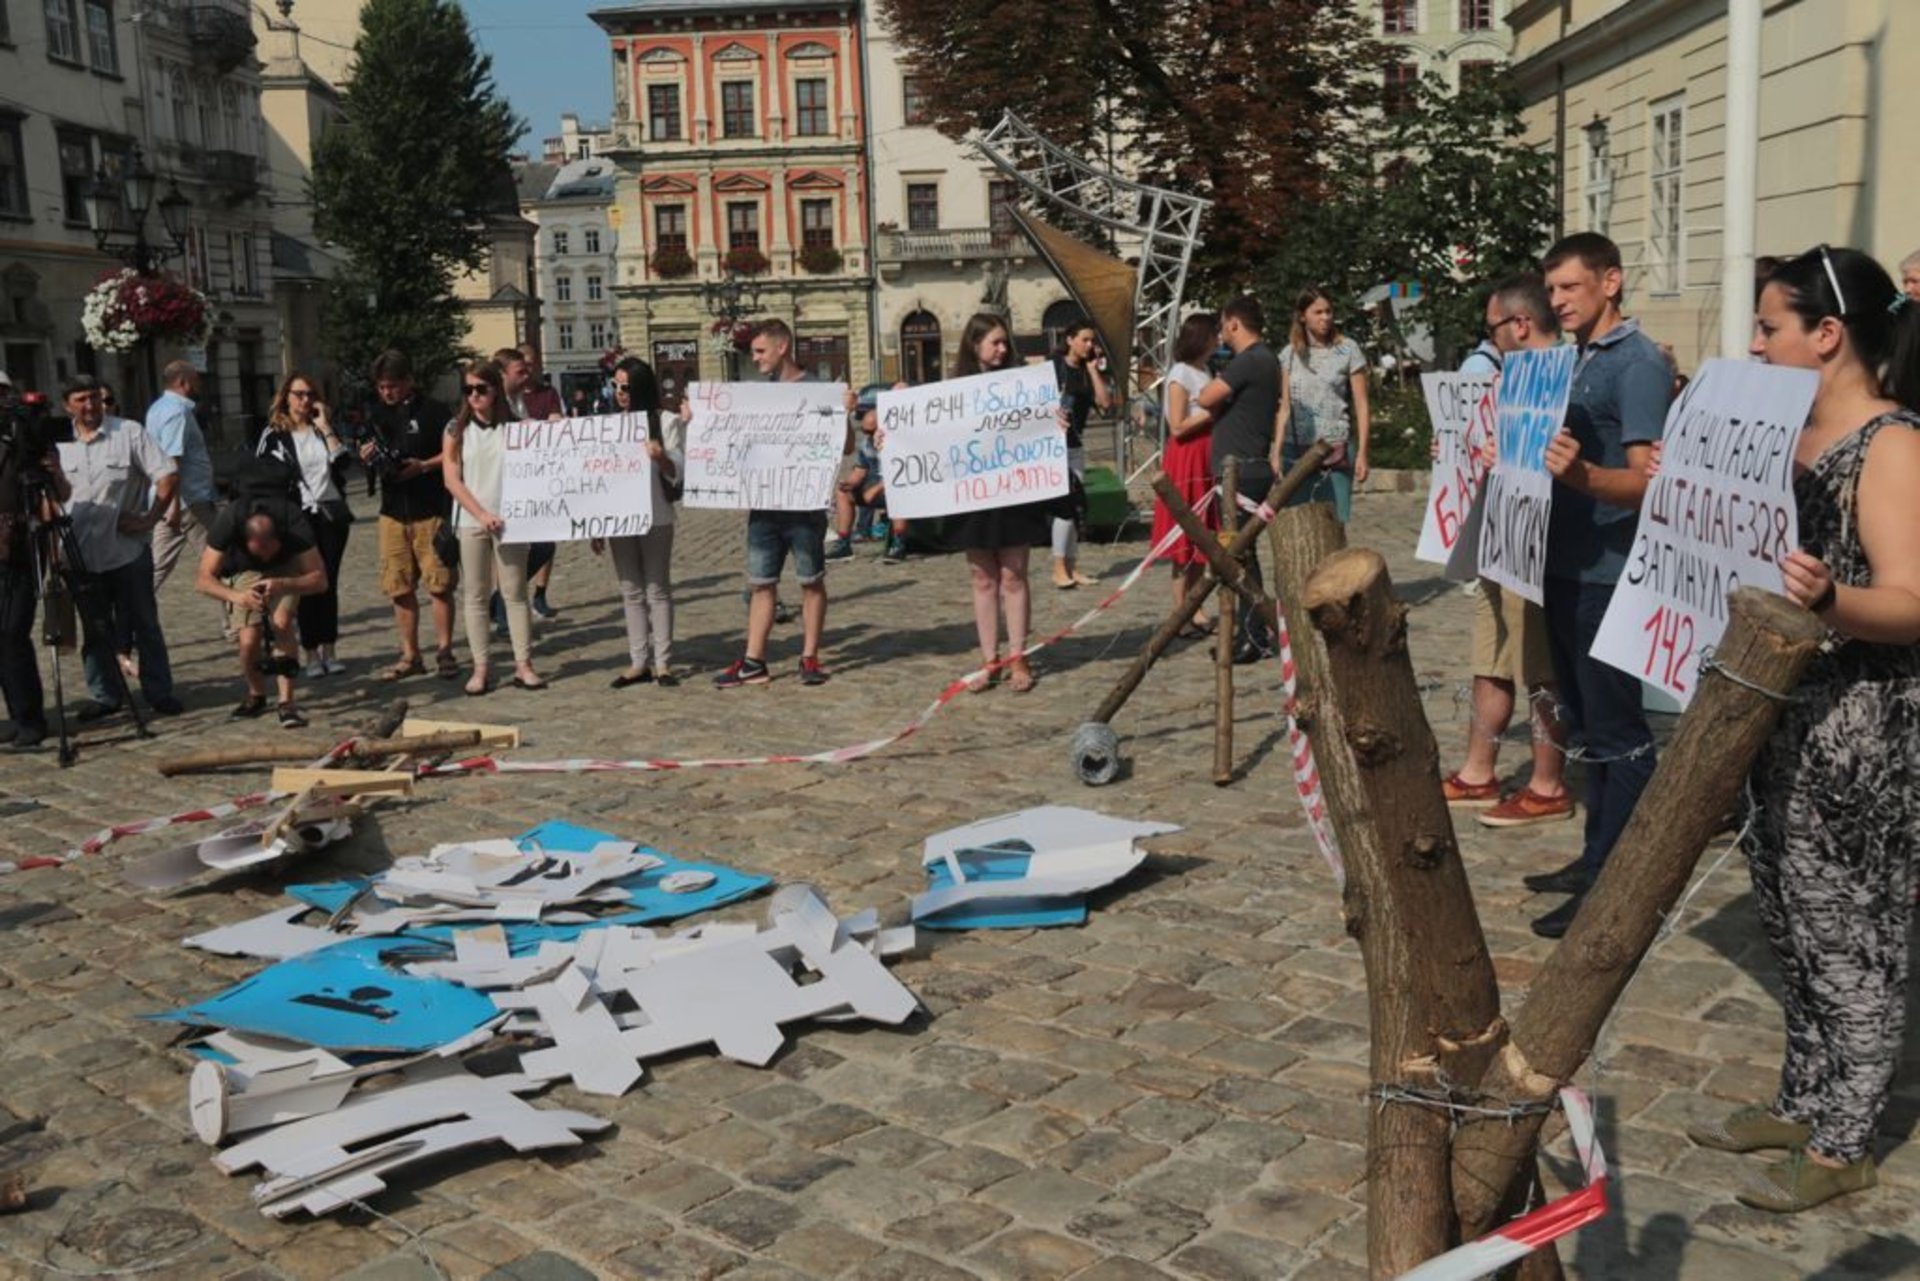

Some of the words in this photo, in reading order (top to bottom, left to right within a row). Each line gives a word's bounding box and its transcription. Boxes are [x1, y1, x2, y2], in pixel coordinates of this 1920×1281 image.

[1437, 381, 1493, 423] СМЕРТ
[506, 411, 648, 451] ЦИТАДЕЛЬ
[974, 406, 1052, 432] людей
[549, 477, 609, 497] ОДНА
[504, 497, 570, 519] ВЕЛИКА
[1650, 476, 1789, 564] ШТАЛАГ-328
[571, 513, 650, 538] МОГИЛА
